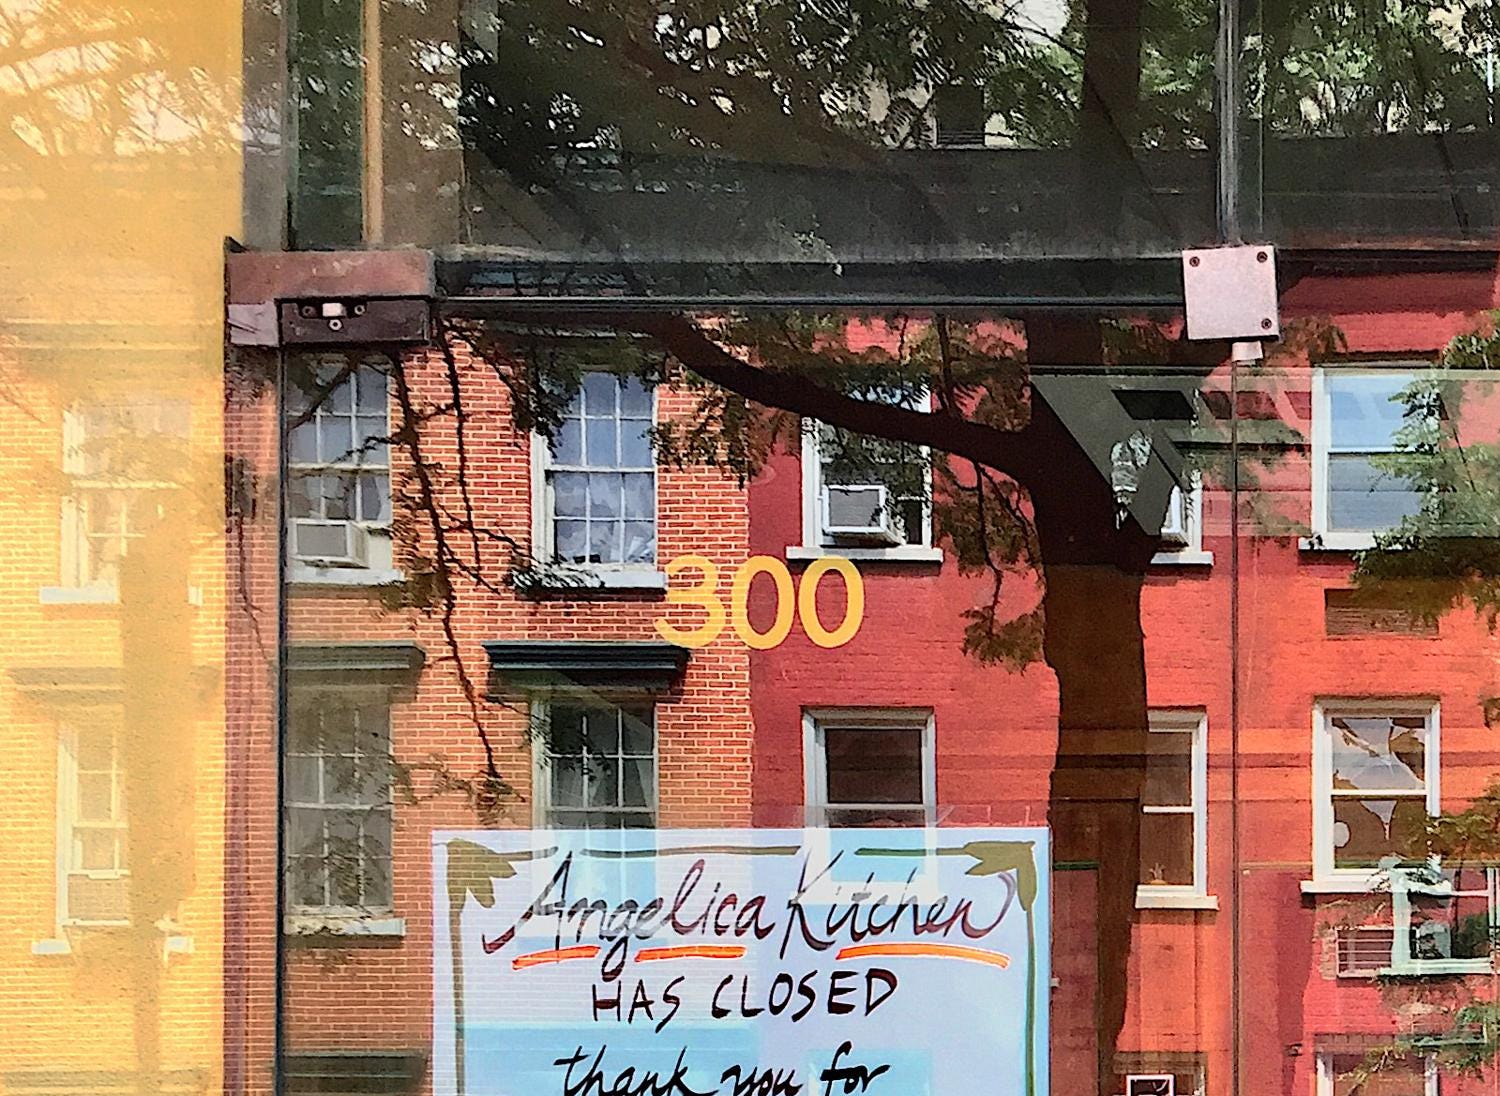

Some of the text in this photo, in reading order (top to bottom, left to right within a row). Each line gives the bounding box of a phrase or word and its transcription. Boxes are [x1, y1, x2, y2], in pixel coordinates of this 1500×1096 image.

[653, 554, 865, 650] 300
[482, 849, 1016, 981] Angelica Kitchen
[591, 968, 900, 1032] HAS CLOSED
